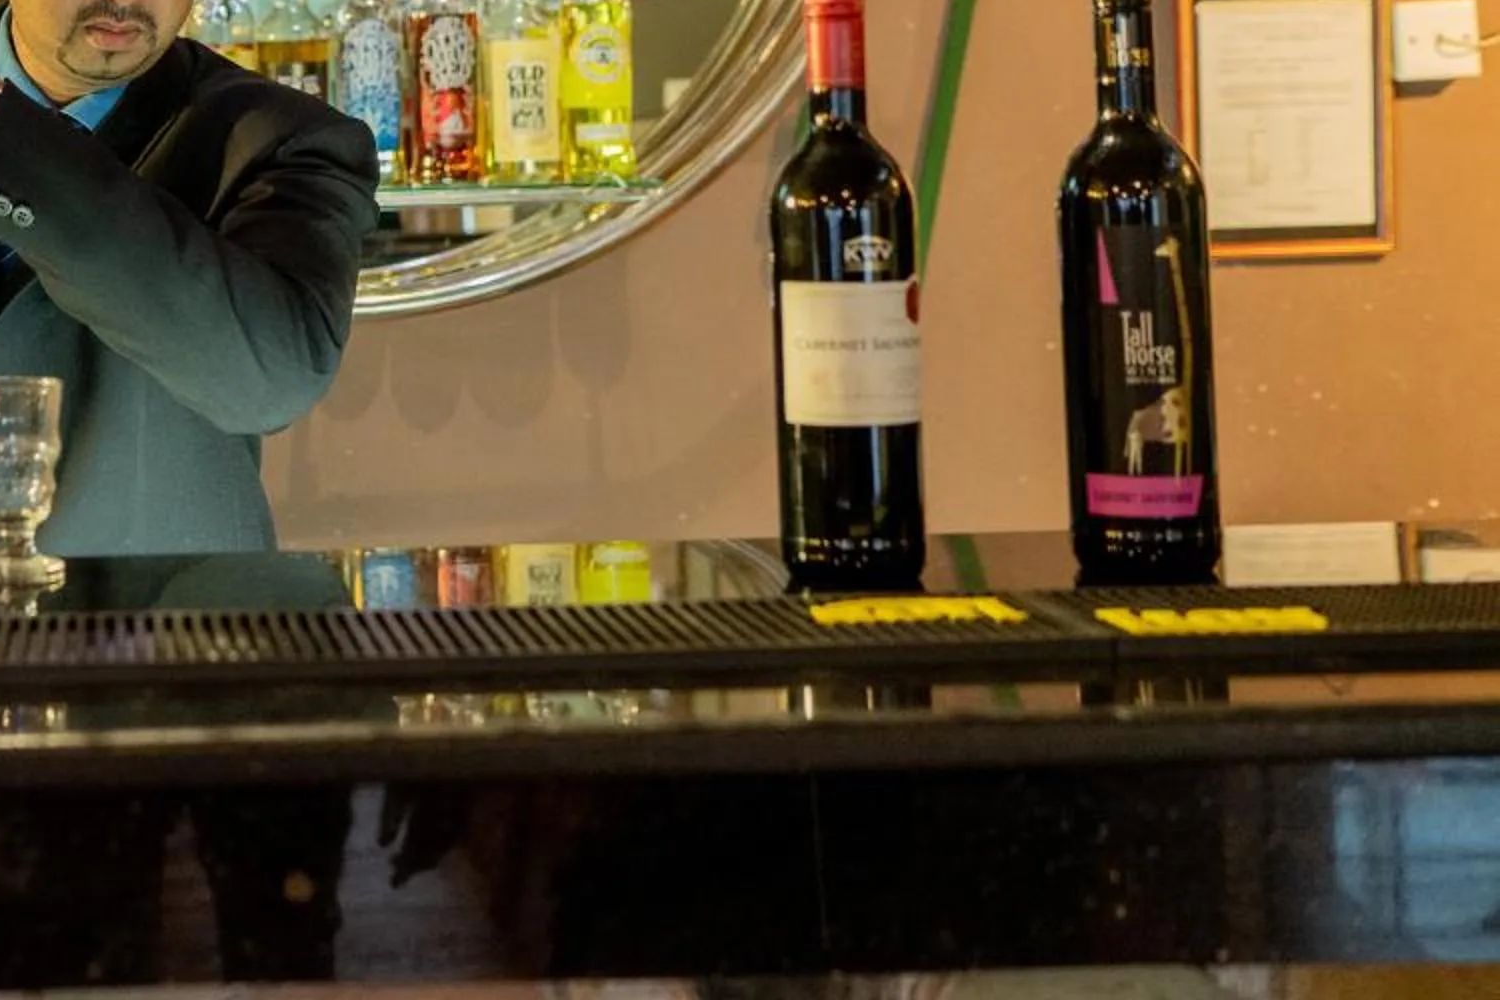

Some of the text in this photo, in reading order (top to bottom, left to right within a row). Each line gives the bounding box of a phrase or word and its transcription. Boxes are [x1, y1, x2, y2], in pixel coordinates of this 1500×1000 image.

[843, 242, 892, 265] KWV
[1119, 312, 1153, 347] Tall
[1124, 344, 1176, 366] horse
